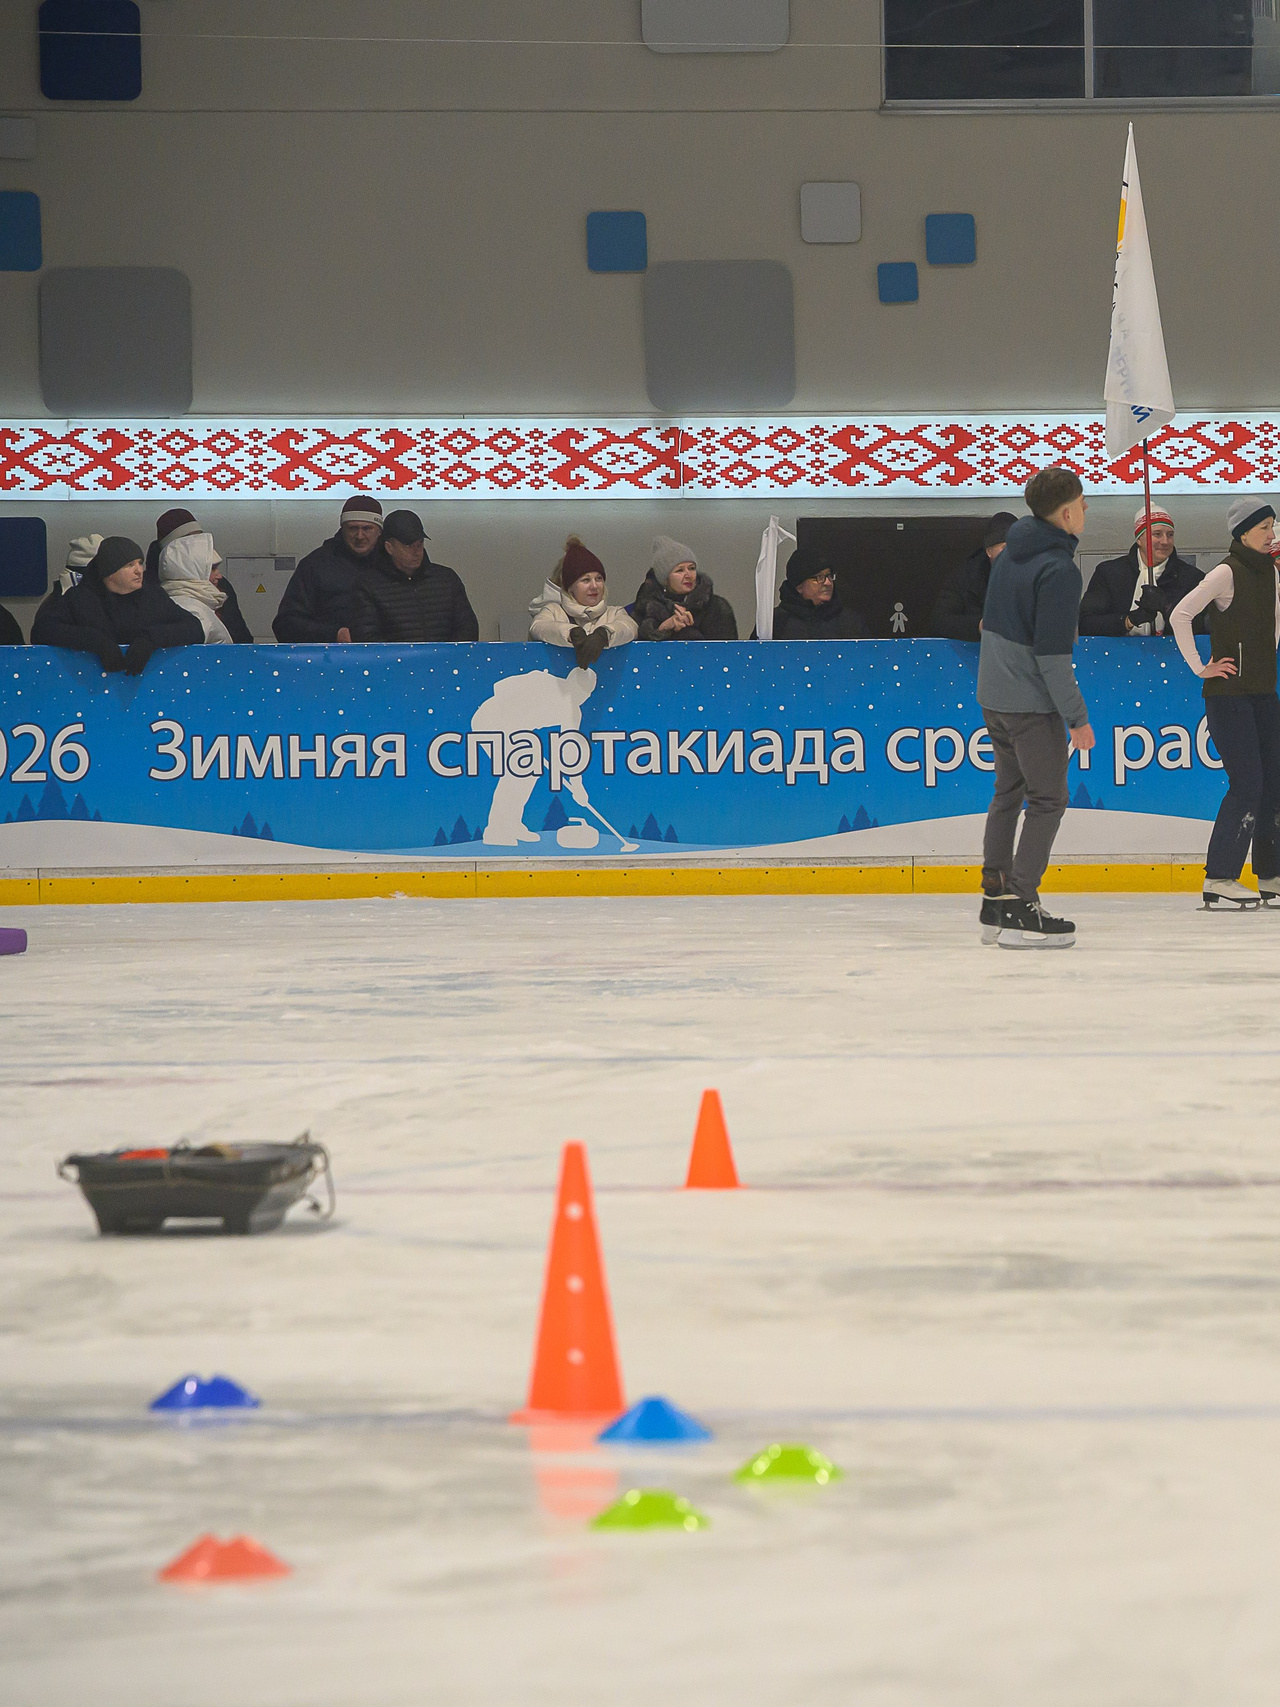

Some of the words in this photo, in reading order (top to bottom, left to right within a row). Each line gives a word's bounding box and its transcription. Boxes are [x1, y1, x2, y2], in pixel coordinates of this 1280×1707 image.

[0, 723, 90, 783] 26
[149, 720, 407, 781] Зимняя
[427, 727, 866, 791] спартакиада
